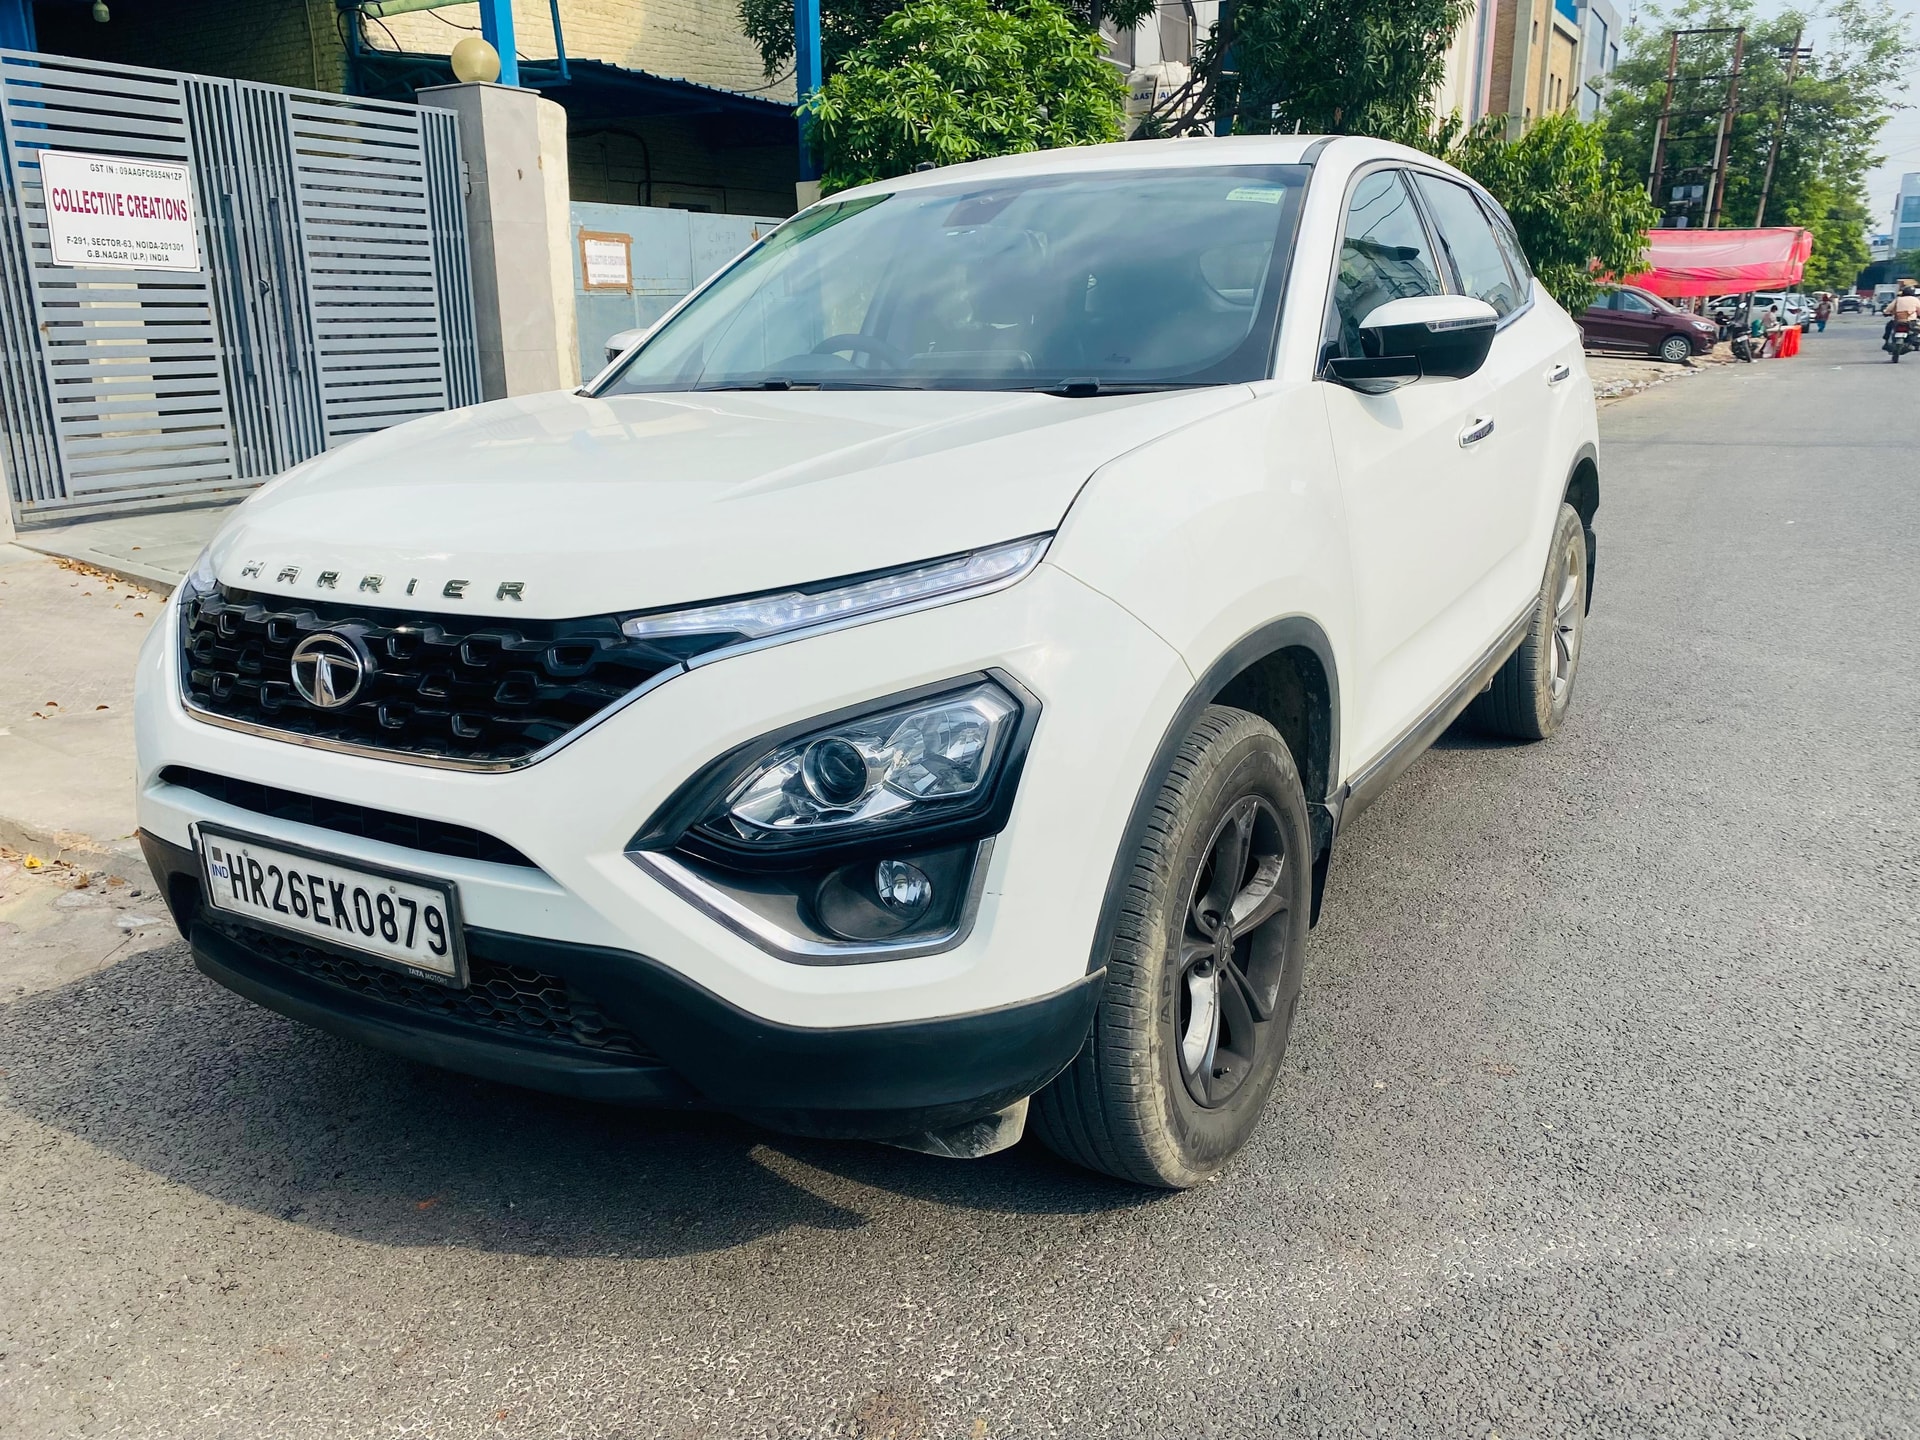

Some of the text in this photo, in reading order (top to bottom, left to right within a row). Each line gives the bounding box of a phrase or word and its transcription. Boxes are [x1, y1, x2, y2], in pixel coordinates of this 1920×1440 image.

[1141, 91, 1170, 101] ASTAL
[90, 163, 104, 173] GST
[106, 165, 114, 174] IN
[52, 187, 188, 222] COLLECTIVE CREATIONS
[66, 236, 185, 252] F-291, SECTOR-63, NOIDA-201301
[87, 250, 170, 263] G.B.NAGAR (U.P.) INDIA
[241, 560, 526, 601] HARRIER
[212, 862, 230, 880] IND
[225, 852, 448, 957] HR26EK0879
[1160, 855, 1198, 1025] APTERRA
[407, 967, 448, 986] TATA MOTORS
